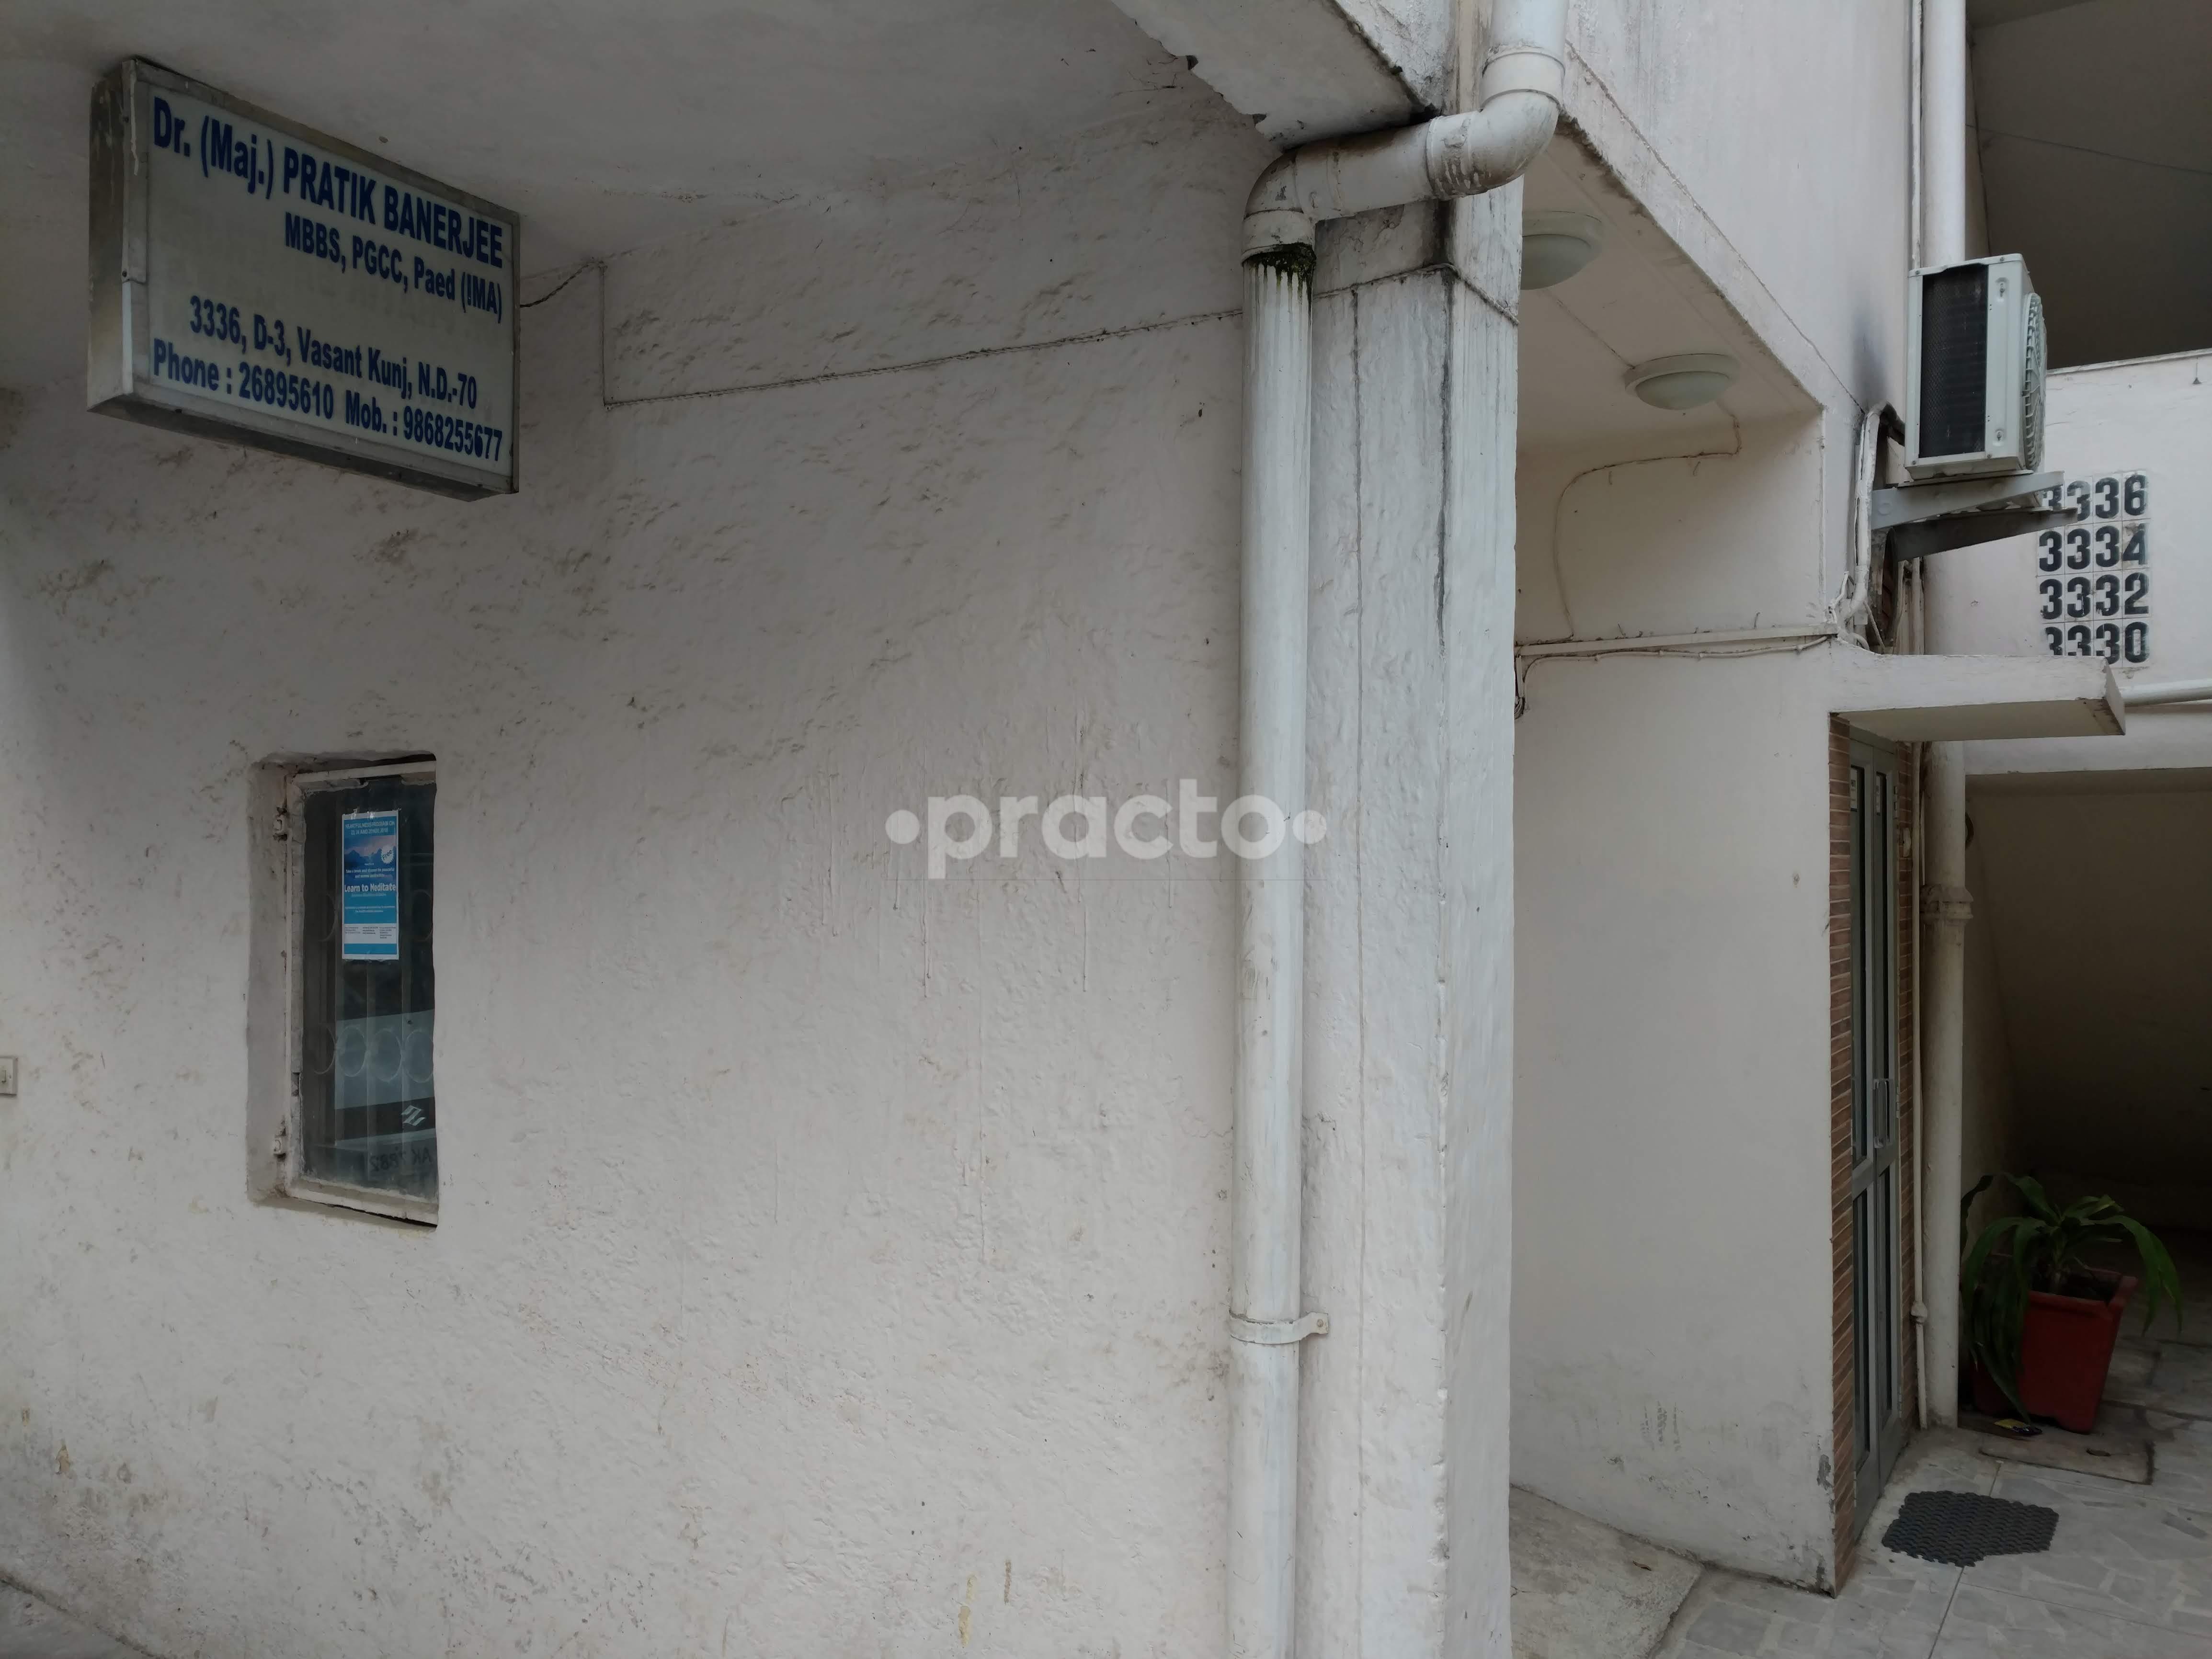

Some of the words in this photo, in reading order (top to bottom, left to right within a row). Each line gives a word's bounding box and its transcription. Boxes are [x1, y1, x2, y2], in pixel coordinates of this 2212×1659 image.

[154, 97, 190, 157] Dr.
[201, 115, 274, 200] (Maj.)
[284, 147, 376, 225] PRATIK
[385, 185, 502, 268] BANERJEE
[285, 212, 346, 273] MBBS,
[353, 235, 408, 294] PGCC,
[414, 256, 455, 300] Paed
[461, 272, 502, 324] (IMA)
[190, 295, 246, 354] 3336,
[254, 314, 291, 366] D-3,
[297, 326, 362, 378] Vasant
[368, 347, 412, 399] Kunj,
[418, 361, 477, 409] N.D.-70
[154, 338, 219, 391] Phone
[239, 362, 334, 419] 26895610
[345, 390, 387, 433] Mob.
[403, 406, 502, 461] 9868255677
[2039, 523, 2148, 572] 3334
[2040, 572, 2149, 620] 3332
[2045, 622, 2149, 665] 3330
[382, 850, 392, 861] Free
[344, 885, 360, 893] Learn
[362, 884, 369, 892] to
[370, 883, 396, 892] Meditate
